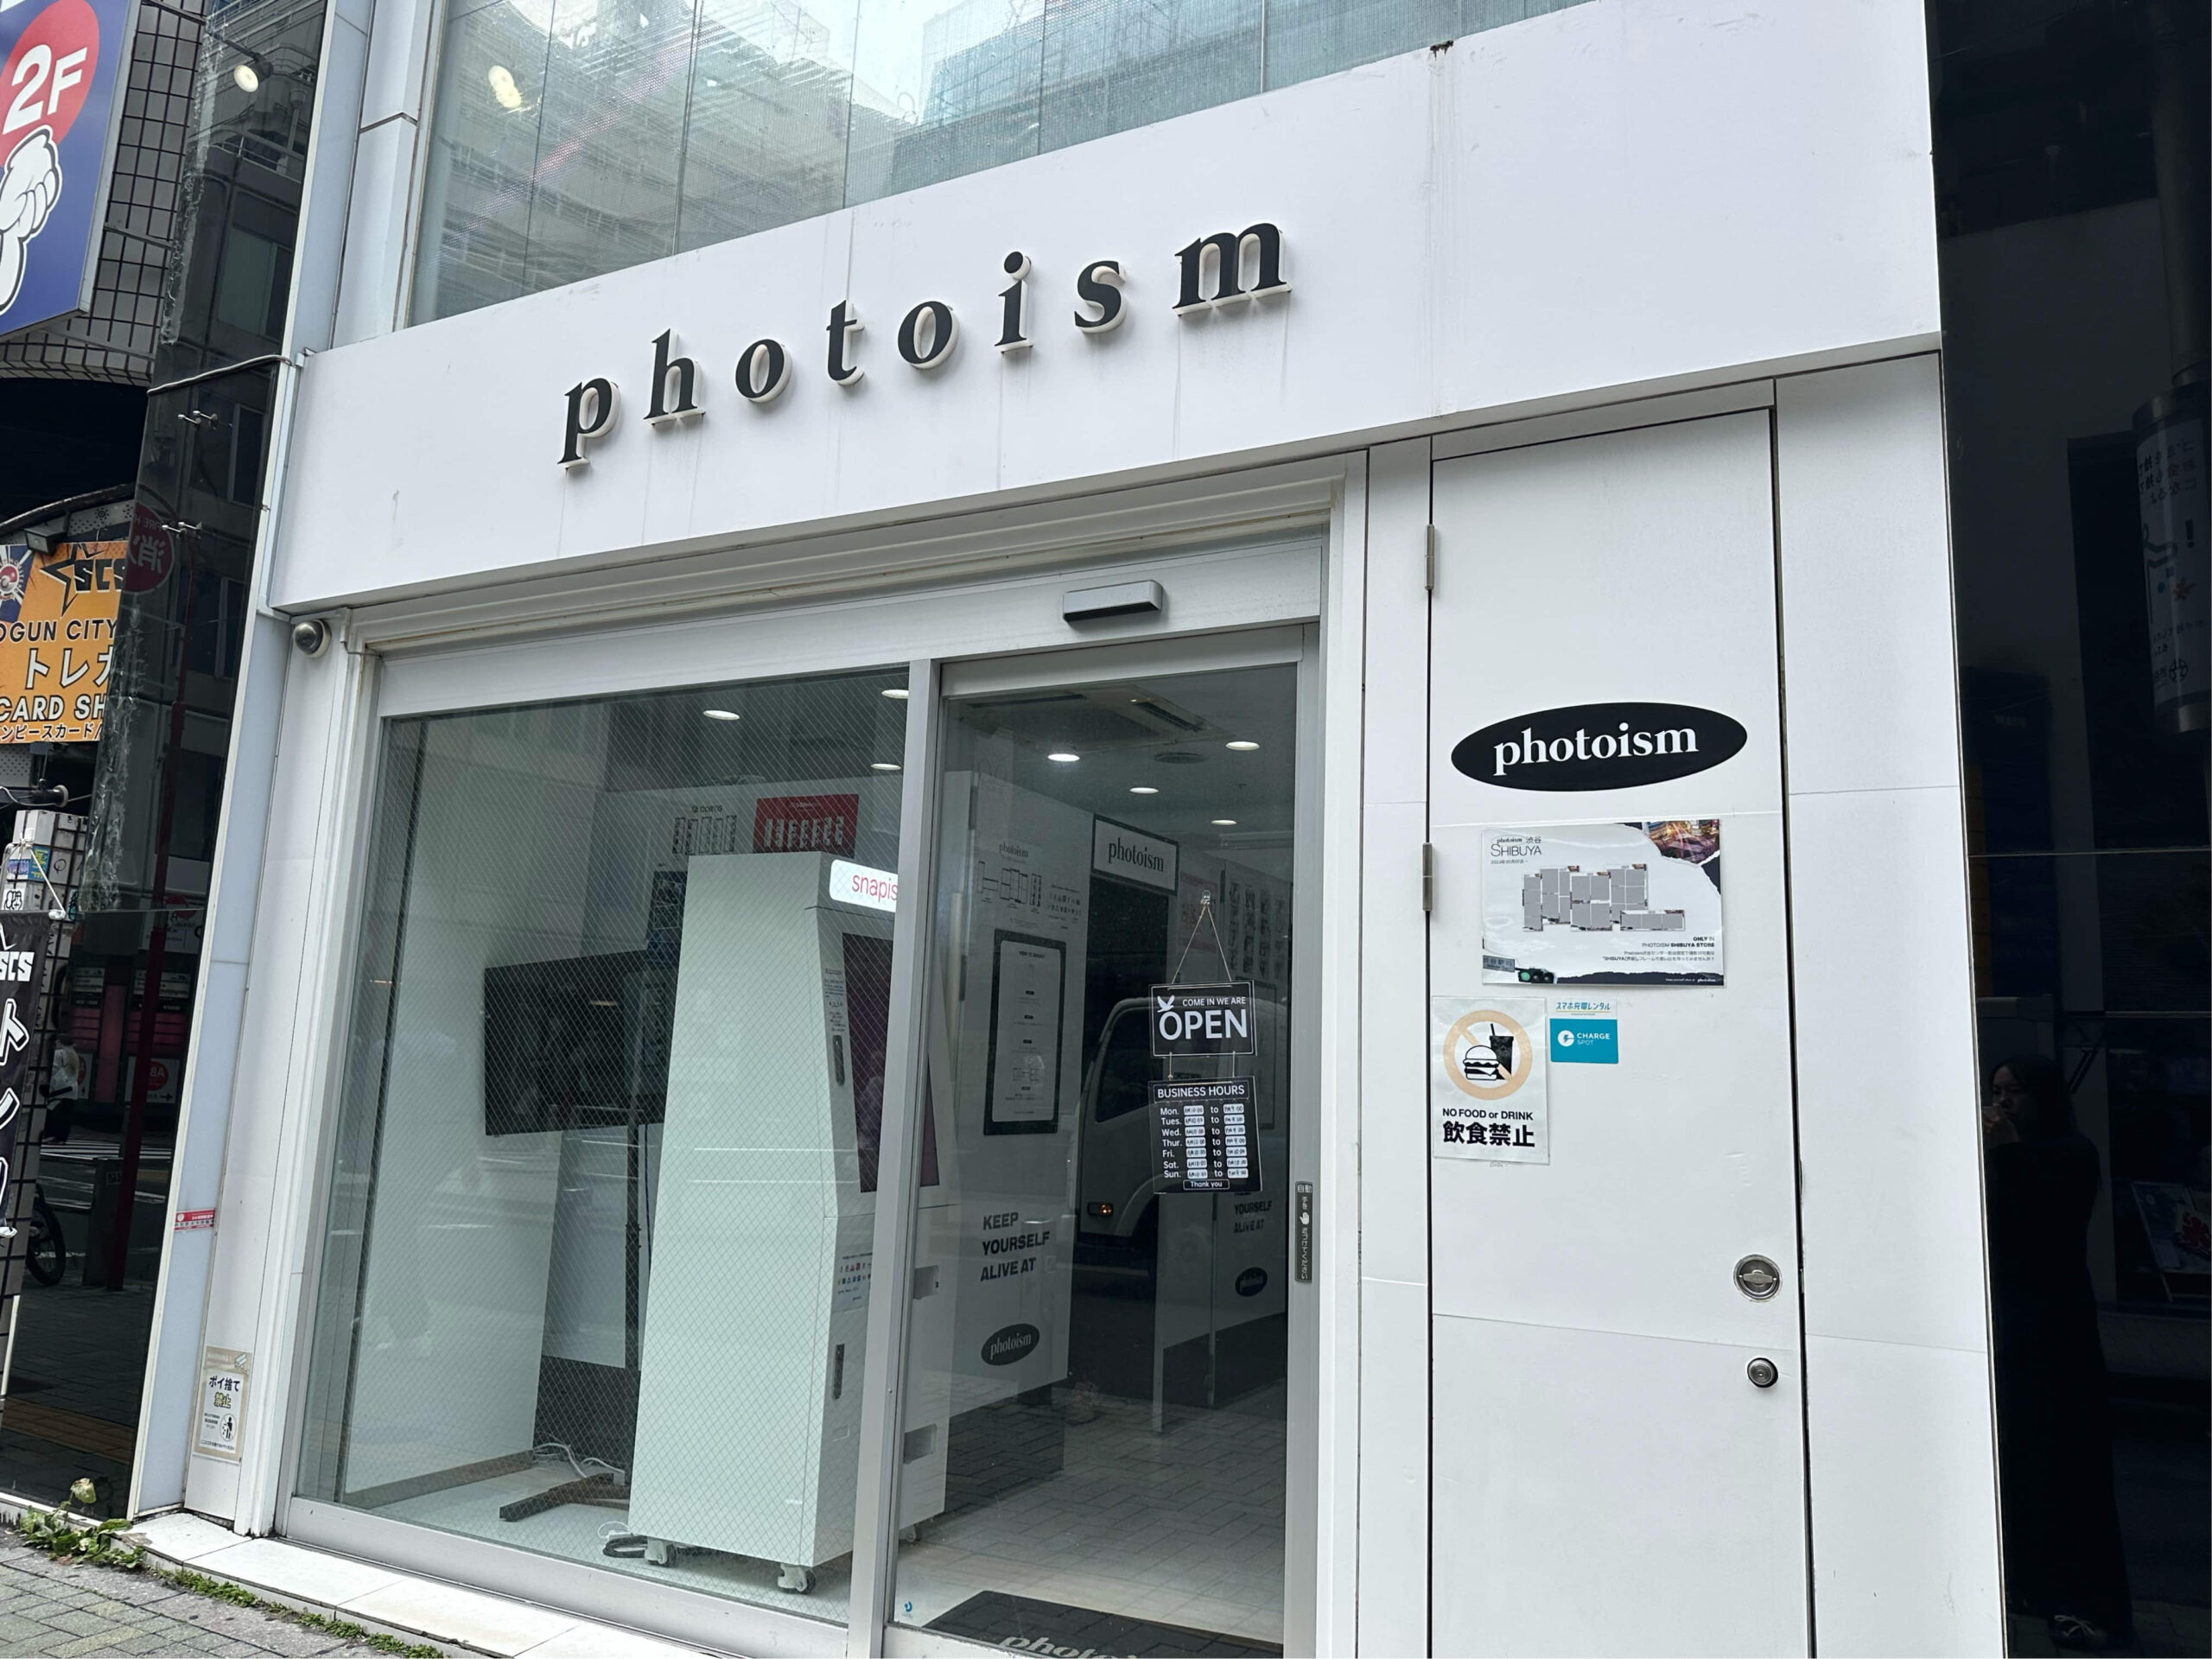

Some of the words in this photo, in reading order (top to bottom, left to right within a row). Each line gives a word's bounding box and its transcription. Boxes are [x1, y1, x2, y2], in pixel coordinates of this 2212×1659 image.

[2, 44, 87, 135] 2F
[557, 222, 1292, 467] photoism
[67, 619, 118, 640] CITY
[1493, 722, 1699, 776] photoism
[1108, 836, 1165, 872] photoism
[1182, 998, 1205, 1007] COME
[1159, 1009, 1248, 1040] OPEN
[1576, 1032, 1611, 1040] CHARGE
[1157, 1086, 1206, 1098] BUSINESS
[1208, 1084, 1245, 1096] HOURS
[1160, 1107, 1179, 1116] Mon.
[1442, 1108, 1458, 1117] NO
[1459, 1109, 1487, 1118] FOOD
[1501, 1110, 1534, 1121] DRINK
[1161, 1128, 1182, 1136] Wed.
[1443, 1120, 1535, 1147] 飲食禁止
[1161, 1139, 1183, 1147] Thur.
[1162, 1149, 1175, 1158] Fri.
[1163, 1160, 1179, 1169] Sat.
[1164, 1170, 1182, 1179] Sun.
[1214, 1169, 1224, 1178] to
[1234, 1199, 1272, 1215] YOURSELF
[982, 1211, 1019, 1230] KEEP
[1233, 1220, 1255, 1234] ALIVE
[982, 1230, 1051, 1255] YOURSELF
[980, 1260, 1019, 1282] ALIVE
[1020, 1256, 1037, 1274] AT
[989, 1332, 1032, 1360] photoism
[209, 1376, 240, 1392] ポイ捨て
[213, 1391, 232, 1409] 禁止
